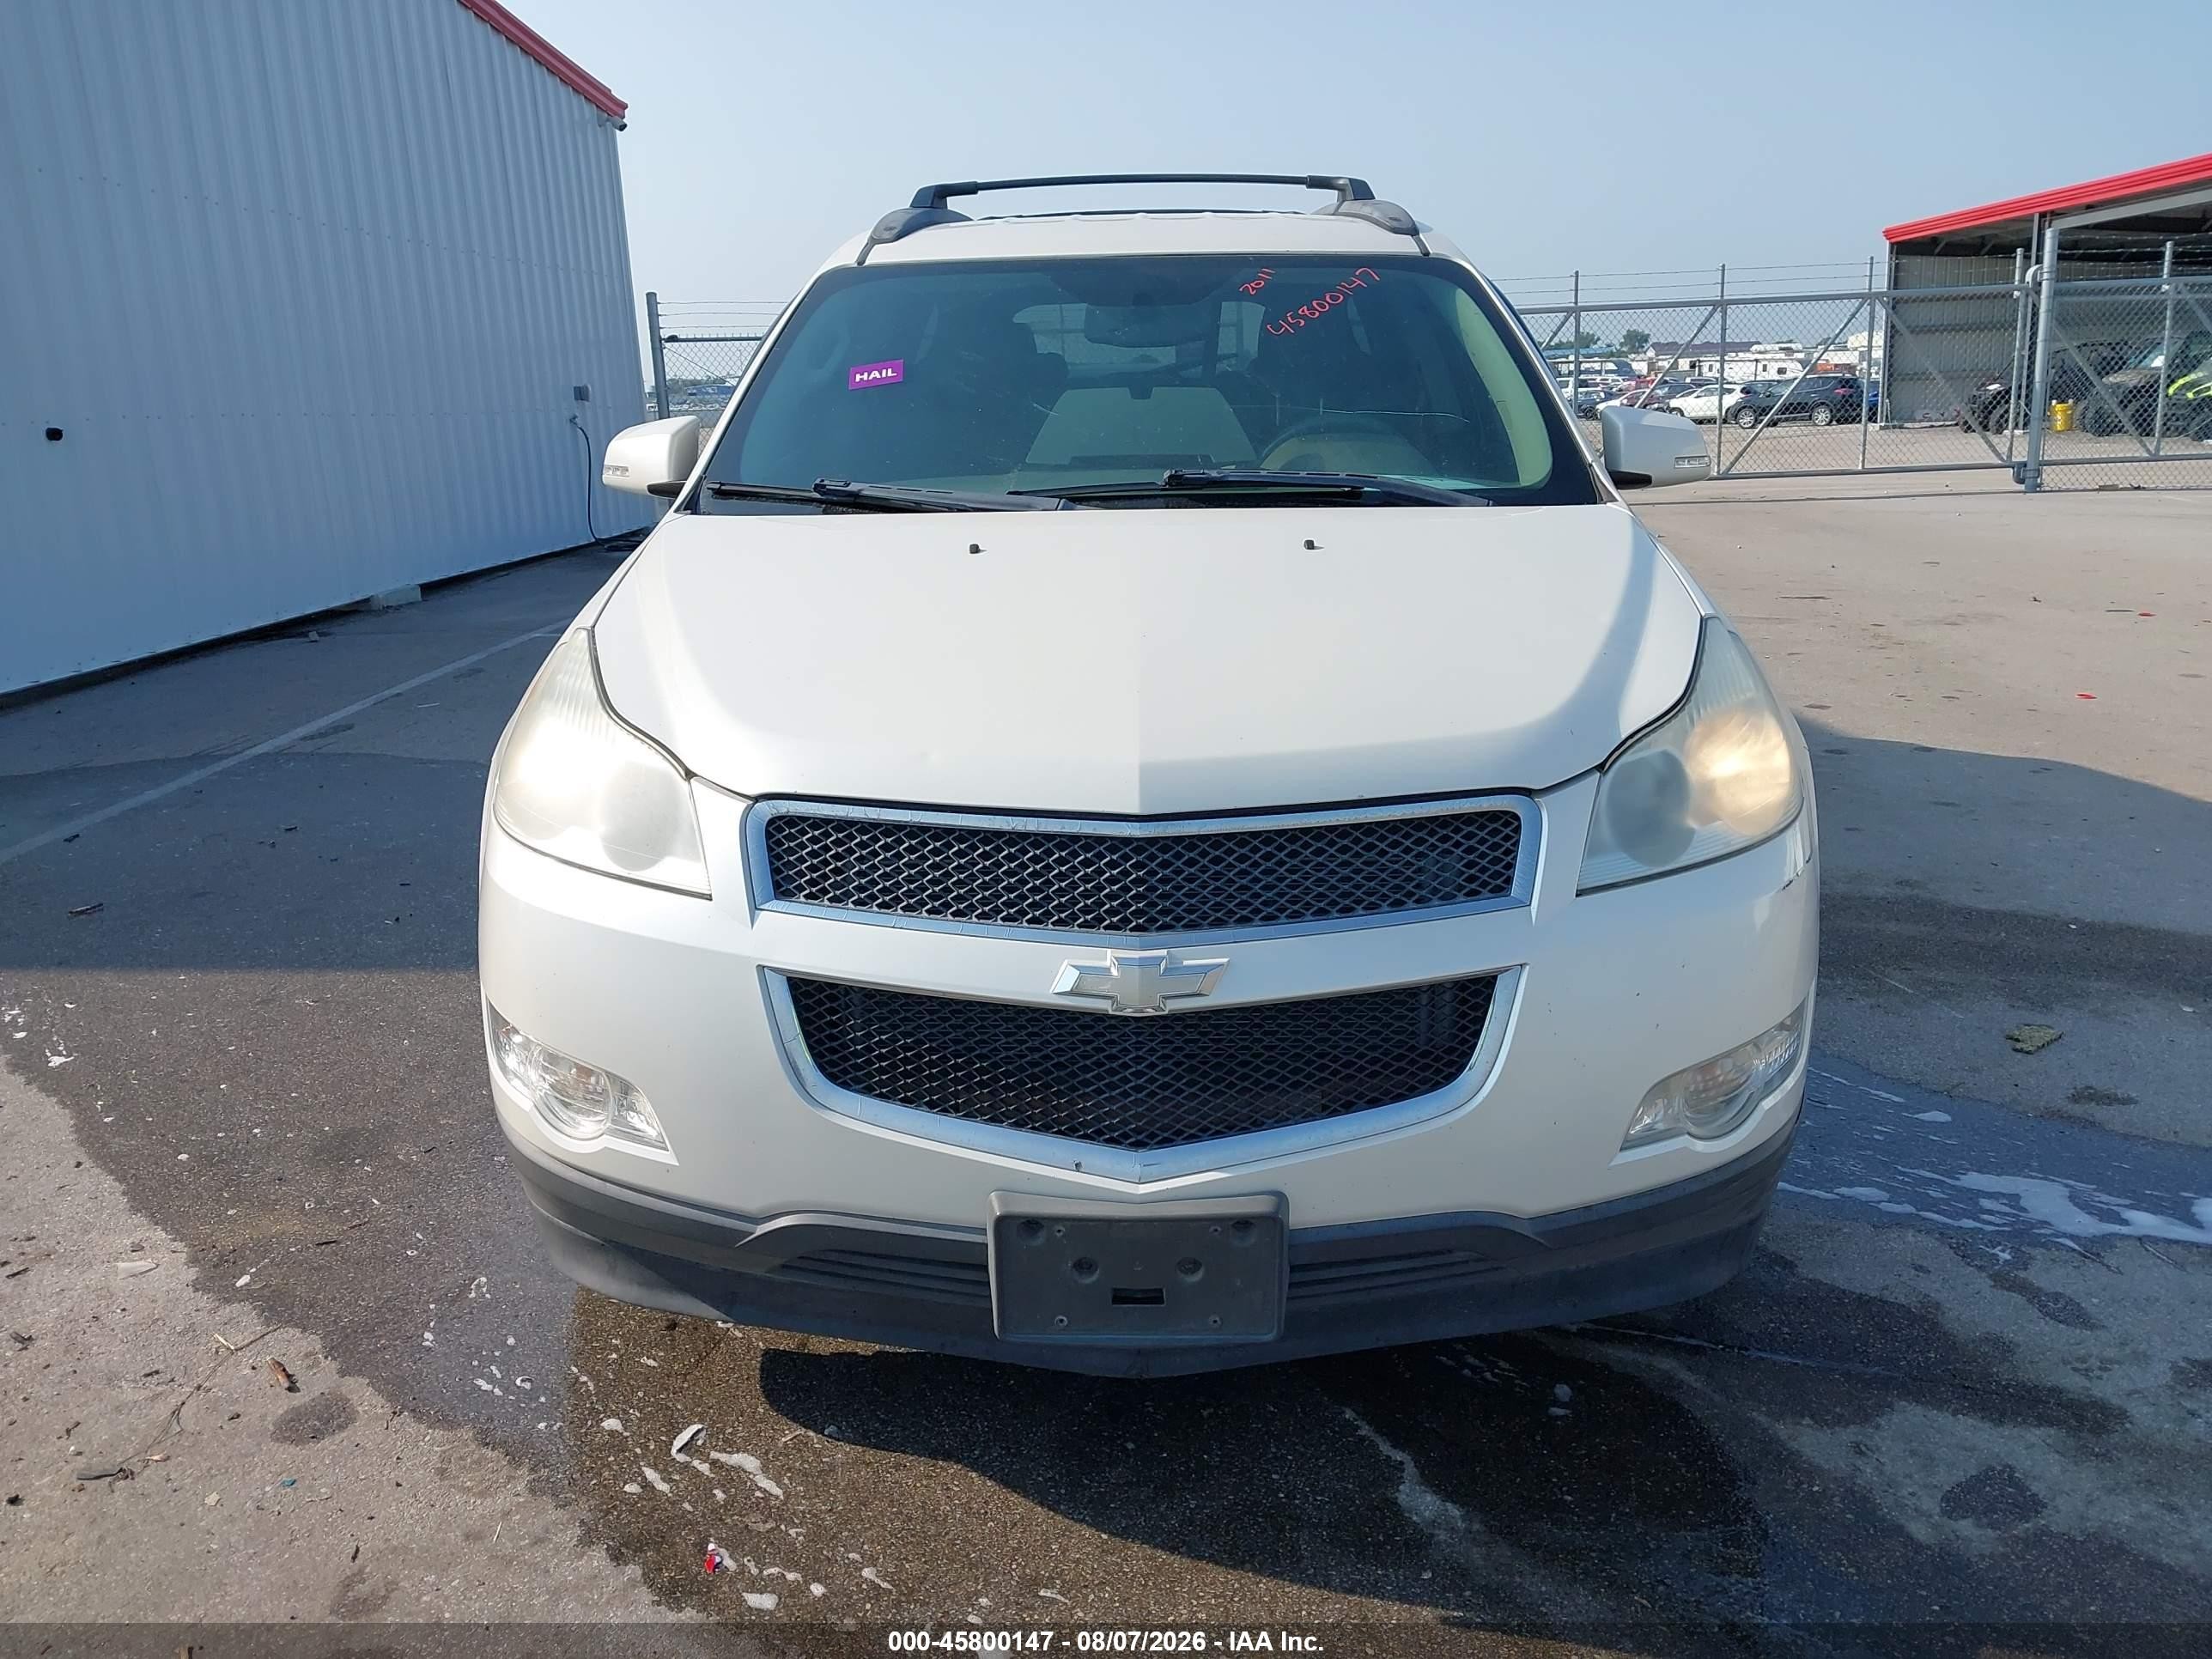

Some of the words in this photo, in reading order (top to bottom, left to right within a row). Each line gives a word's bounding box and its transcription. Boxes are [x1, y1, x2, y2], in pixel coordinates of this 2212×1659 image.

[1238, 268, 1276, 295] 2011
[1267, 267, 1380, 336] 45800147
[855, 368, 897, 382] HAIL
